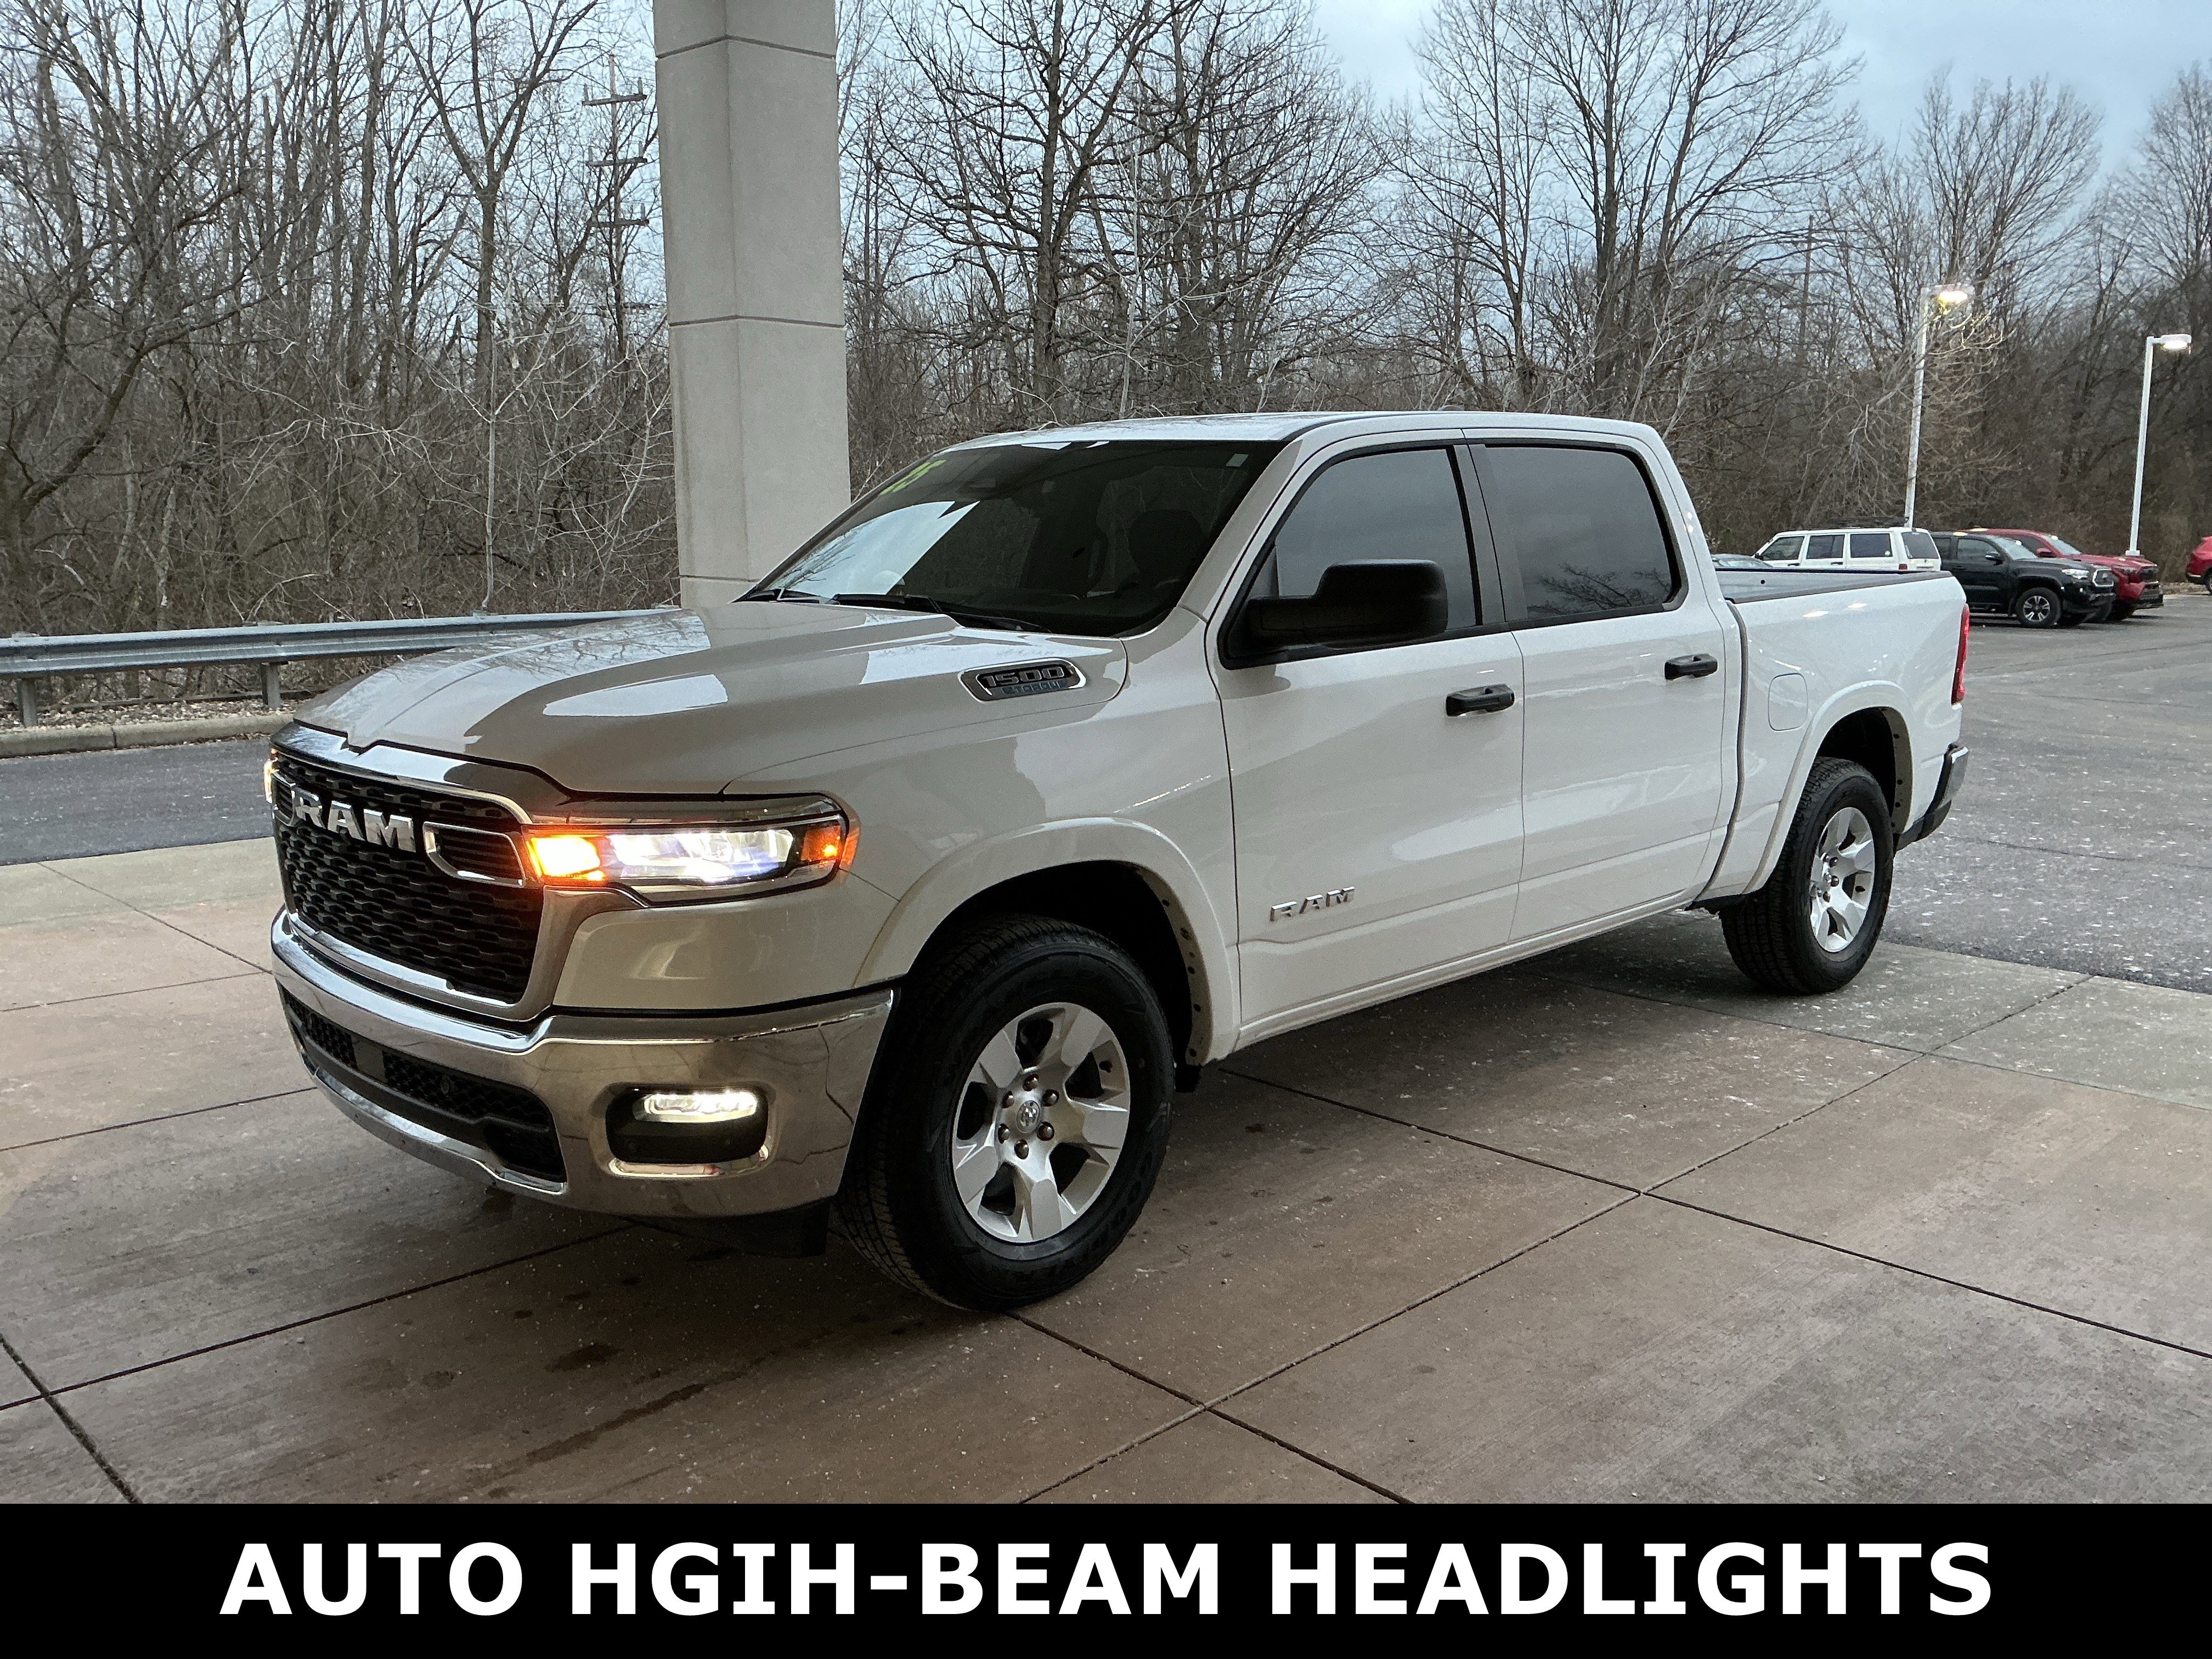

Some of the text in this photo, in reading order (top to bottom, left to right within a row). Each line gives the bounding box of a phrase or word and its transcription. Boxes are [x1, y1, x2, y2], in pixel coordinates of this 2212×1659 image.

[982, 667, 1064, 686] 1500
[295, 786, 416, 853] RAM
[1269, 886, 1355, 922] RAM
